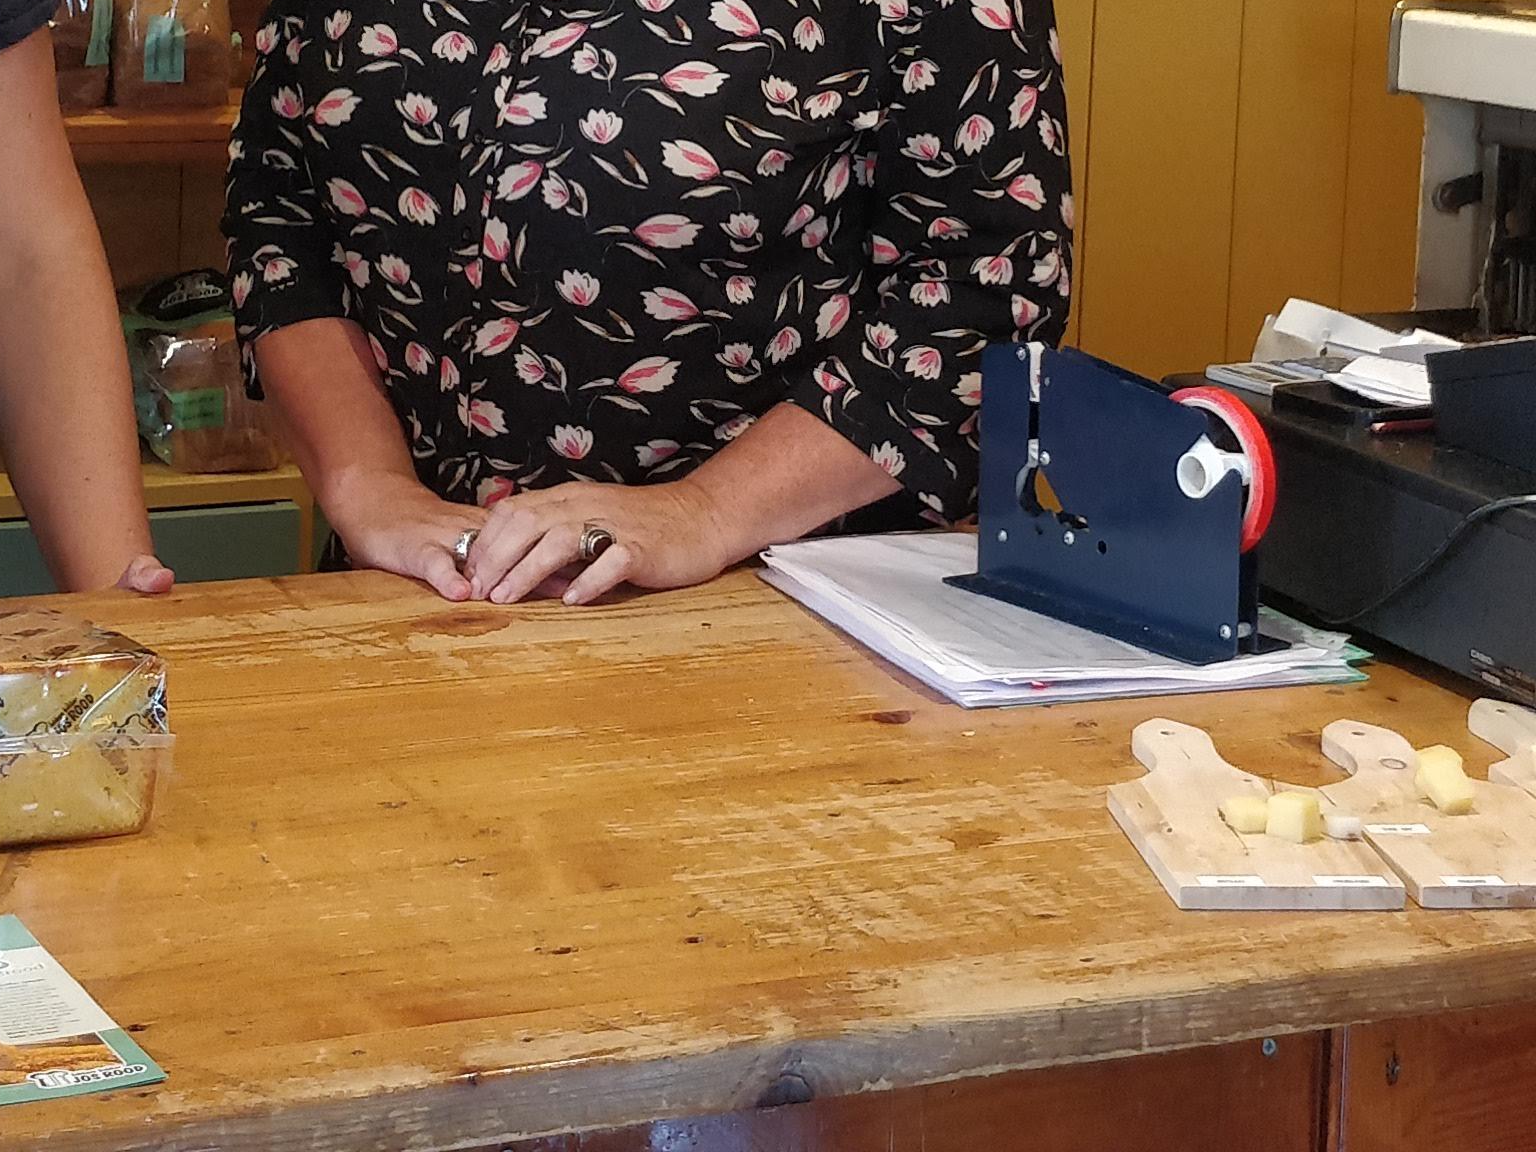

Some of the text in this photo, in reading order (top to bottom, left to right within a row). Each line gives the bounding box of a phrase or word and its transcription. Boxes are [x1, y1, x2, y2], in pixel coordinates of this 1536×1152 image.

[68, 694, 94, 721] ROOD
[73, 1073, 101, 1084] JOS
[103, 1065, 144, 1078] ROOD
